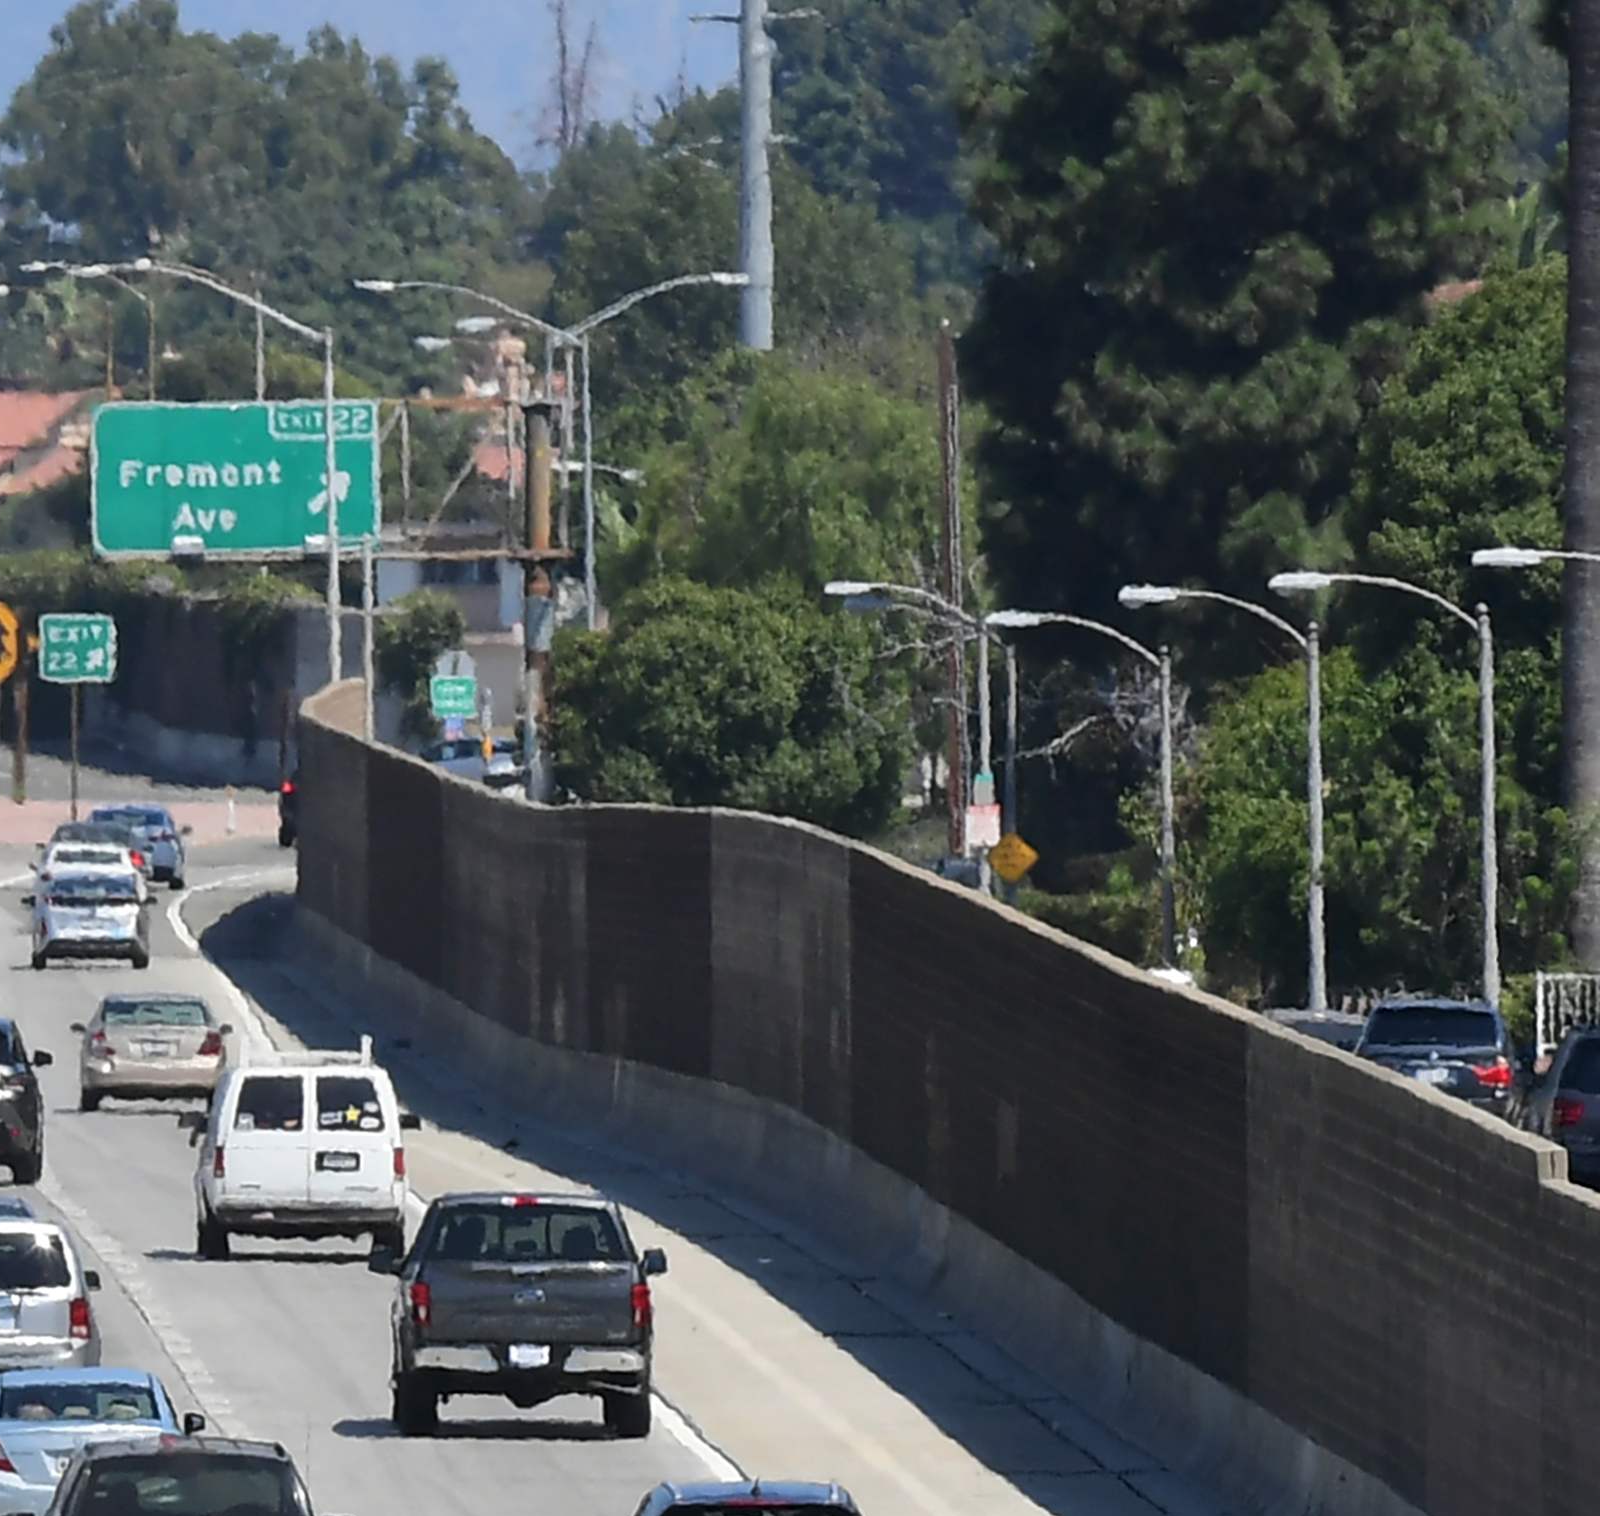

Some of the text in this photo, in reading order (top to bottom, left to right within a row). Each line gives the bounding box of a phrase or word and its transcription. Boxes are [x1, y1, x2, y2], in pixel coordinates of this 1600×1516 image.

[278, 407, 369, 431] EXIT 22
[119, 460, 282, 488] Fremont
[173, 503, 238, 533] Ave
[48, 624, 103, 643] EXIT
[48, 651, 78, 672] 22
